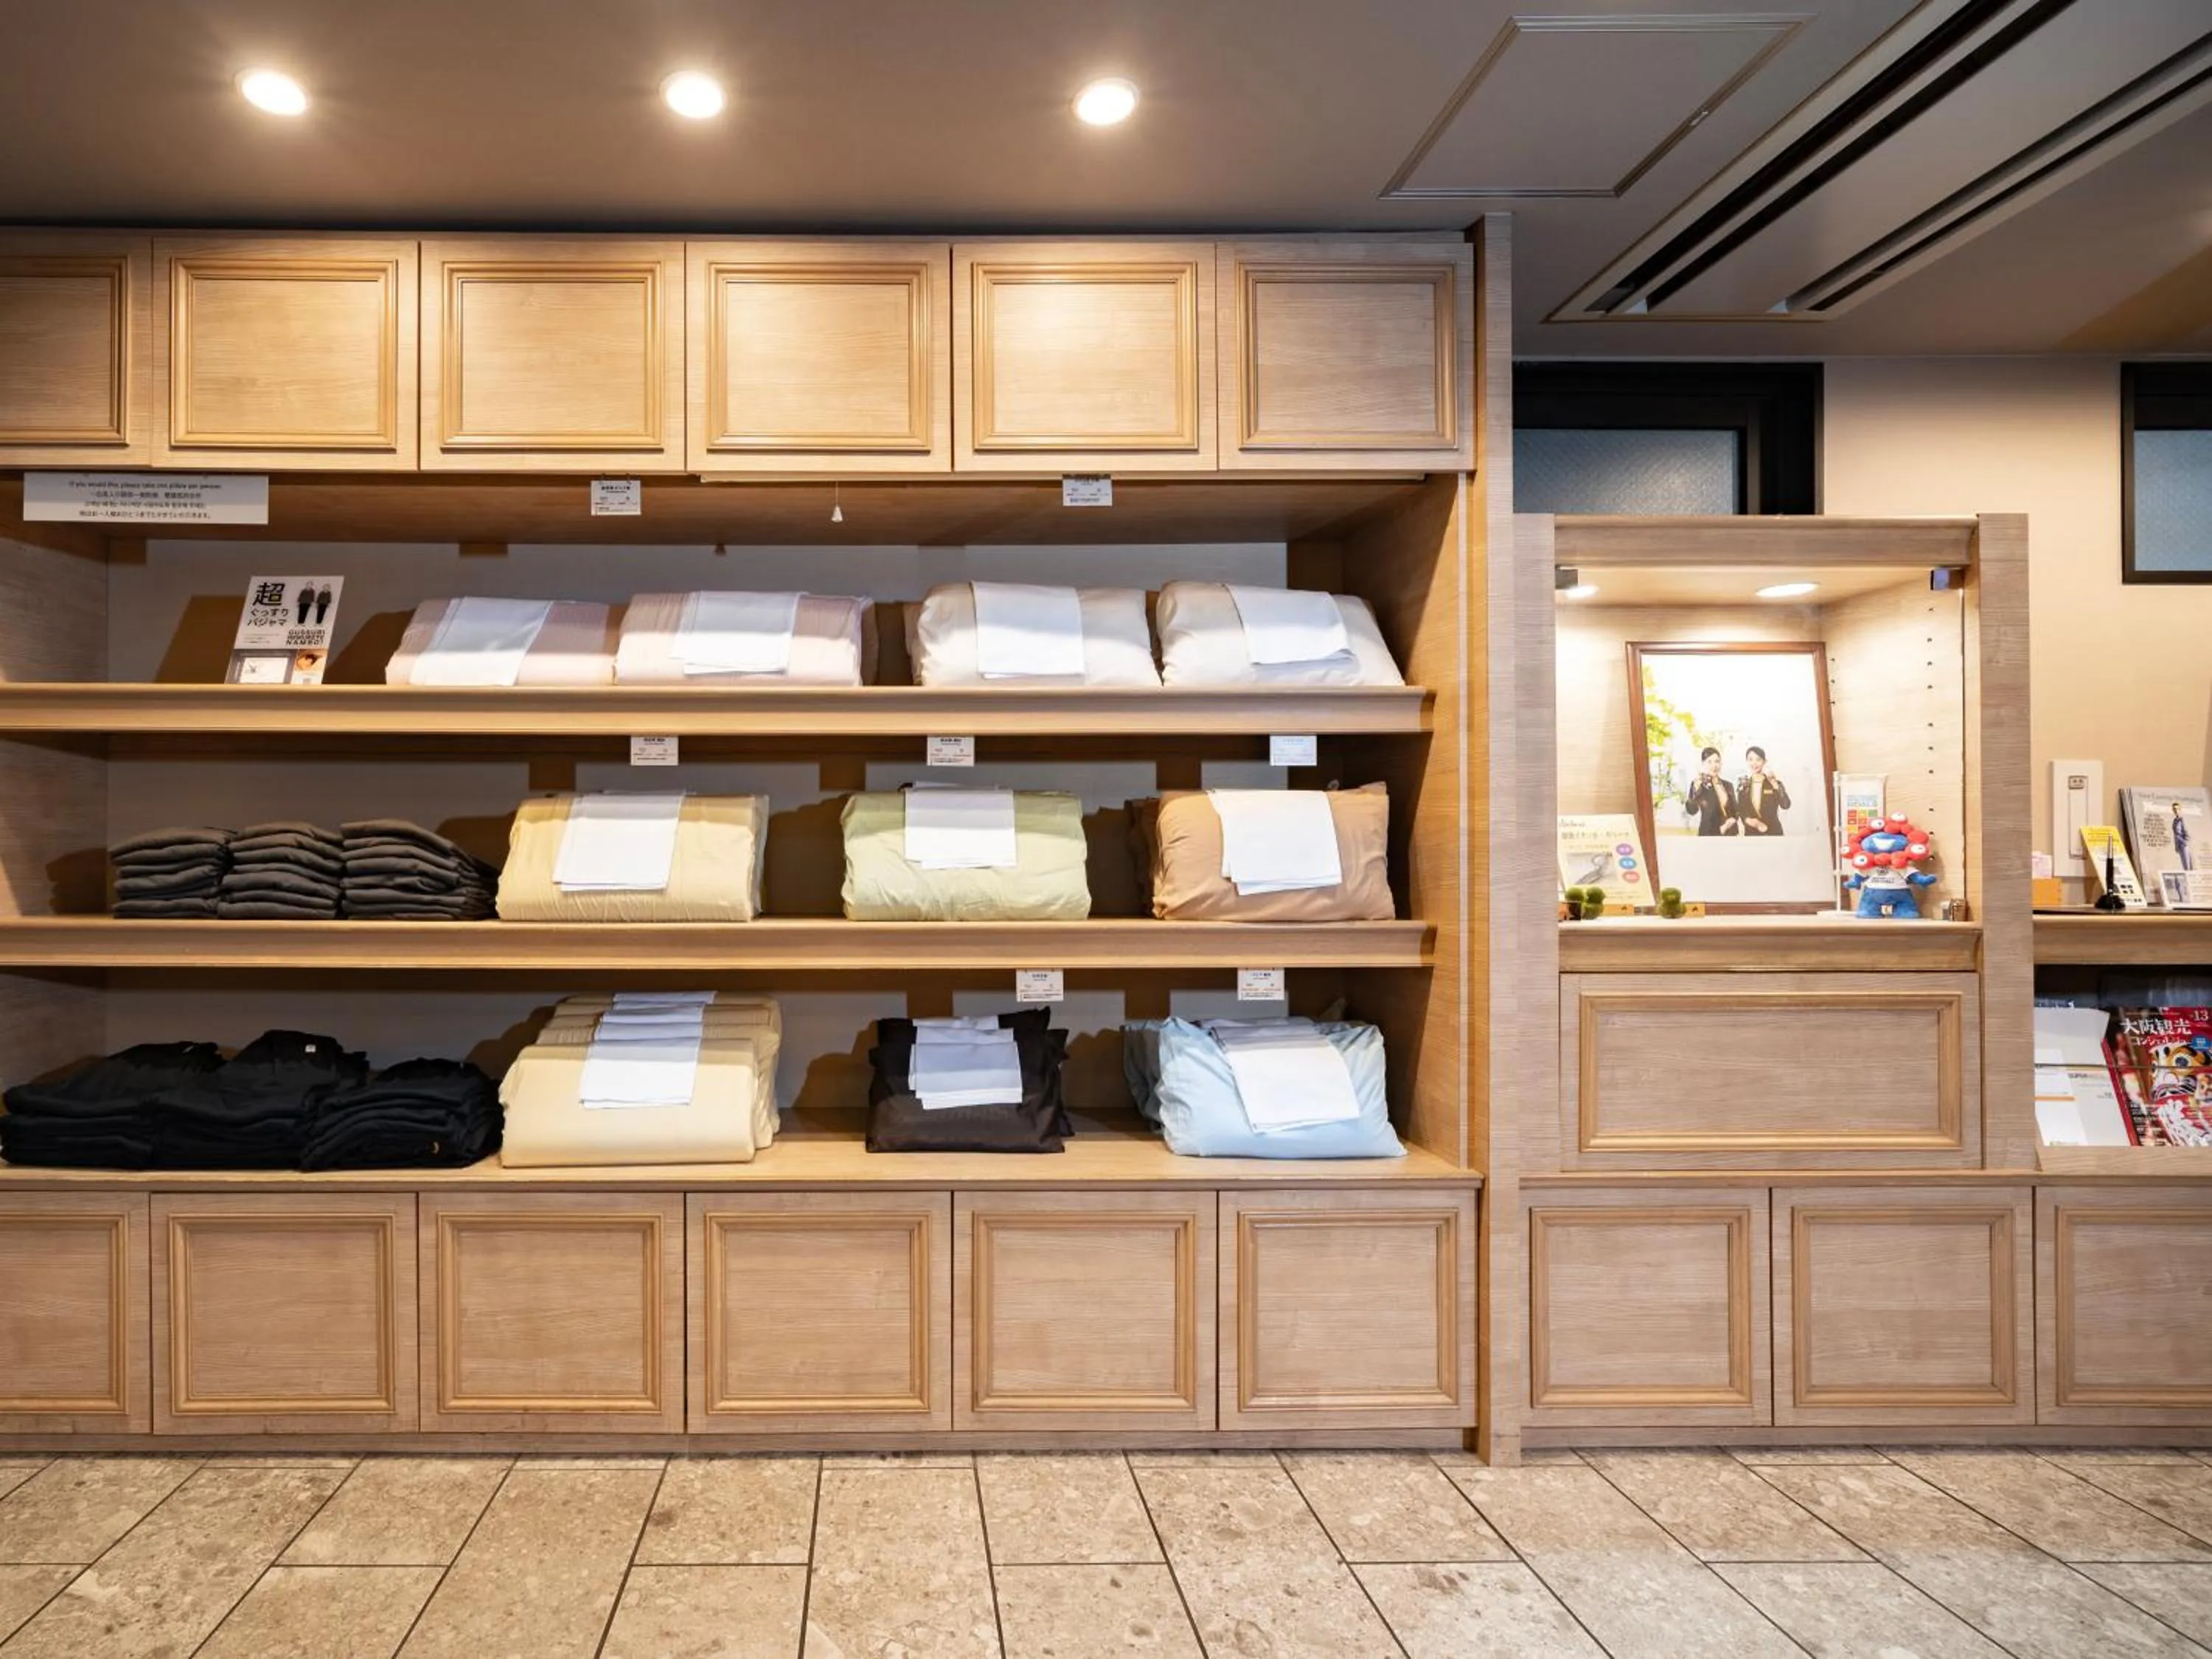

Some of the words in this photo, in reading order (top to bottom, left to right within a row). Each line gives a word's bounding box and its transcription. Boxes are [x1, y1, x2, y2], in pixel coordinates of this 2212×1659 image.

[252, 582, 285, 606] 超
[250, 608, 290, 617] ぐっすり
[247, 618, 288, 627] パジャマ
[2120, 1018, 2191, 1035] 大阪観光
